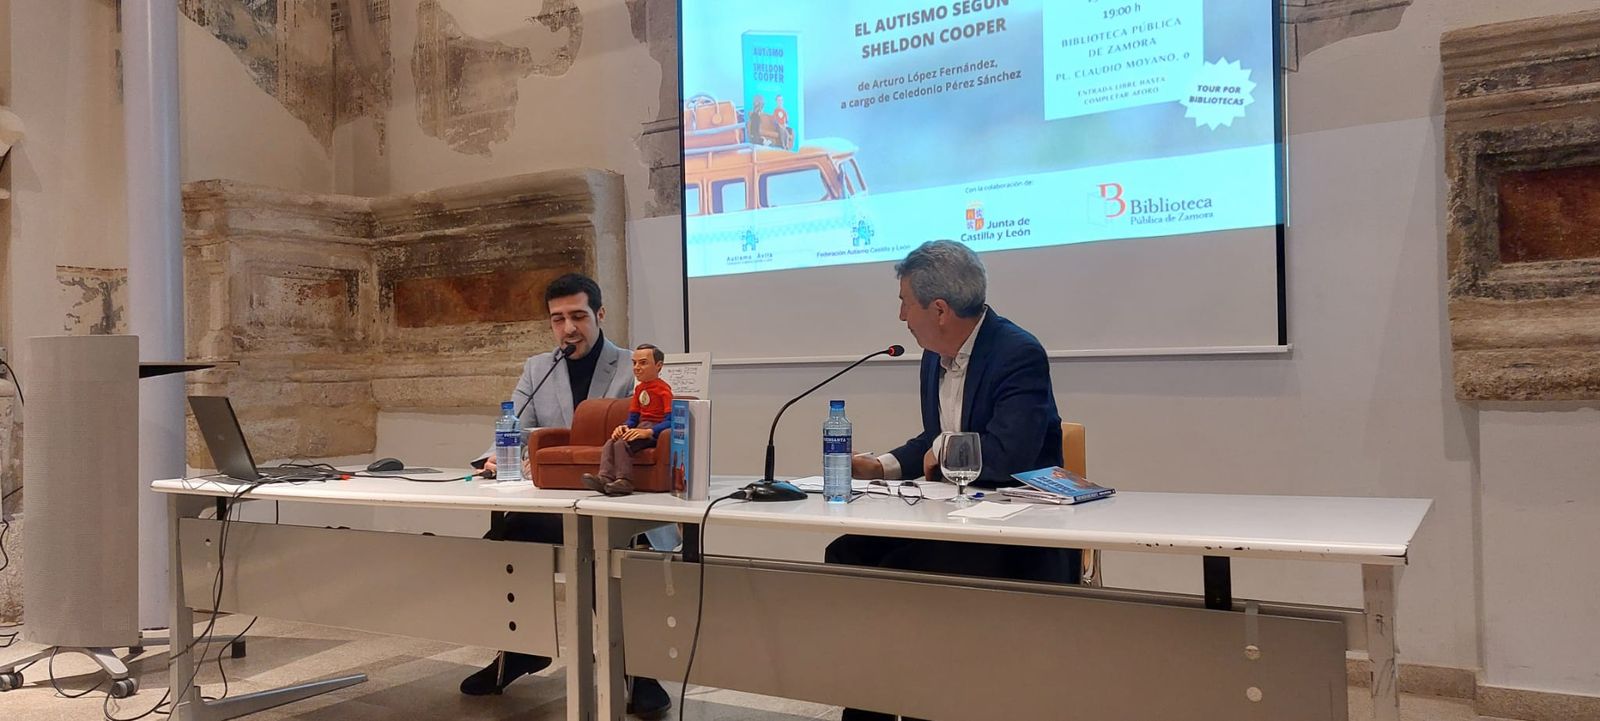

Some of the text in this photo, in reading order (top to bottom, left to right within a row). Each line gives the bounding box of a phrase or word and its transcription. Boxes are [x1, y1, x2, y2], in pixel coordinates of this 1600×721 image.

[1103, 2, 1141, 19] 19:00 h
[854, 23, 871, 37] EL
[874, 6, 948, 33] AUTISMO
[862, 17, 1007, 59] SHELDON COOPER
[1061, 17, 1182, 48] BIBLIOTECA PÚBLICA
[753, 47, 784, 58] AUTISMO
[1088, 37, 1157, 58] DE ZAMORA
[753, 64, 784, 73] SHELDON
[858, 58, 998, 92] de Arturo López Fernández,
[1056, 72, 1070, 81] PL.
[1074, 58, 1122, 78] CLAUDIO
[753, 72, 784, 84] COOPER
[841, 70, 1022, 109] a cargo de Celedonio Pérez Sánchez
[1197, 84, 1241, 94] TOUR POR
[1188, 96, 1244, 106] BIBLIOTECAS
[965, 186, 976, 194] Con
[984, 180, 1024, 191] colaboración
[1130, 198, 1212, 215] Biblioteca
[986, 217, 1030, 230] Junta de
[1130, 211, 1214, 225] Pública de Zamora
[960, 228, 1031, 242] Castilla y León
[816, 249, 846, 258] Federación
